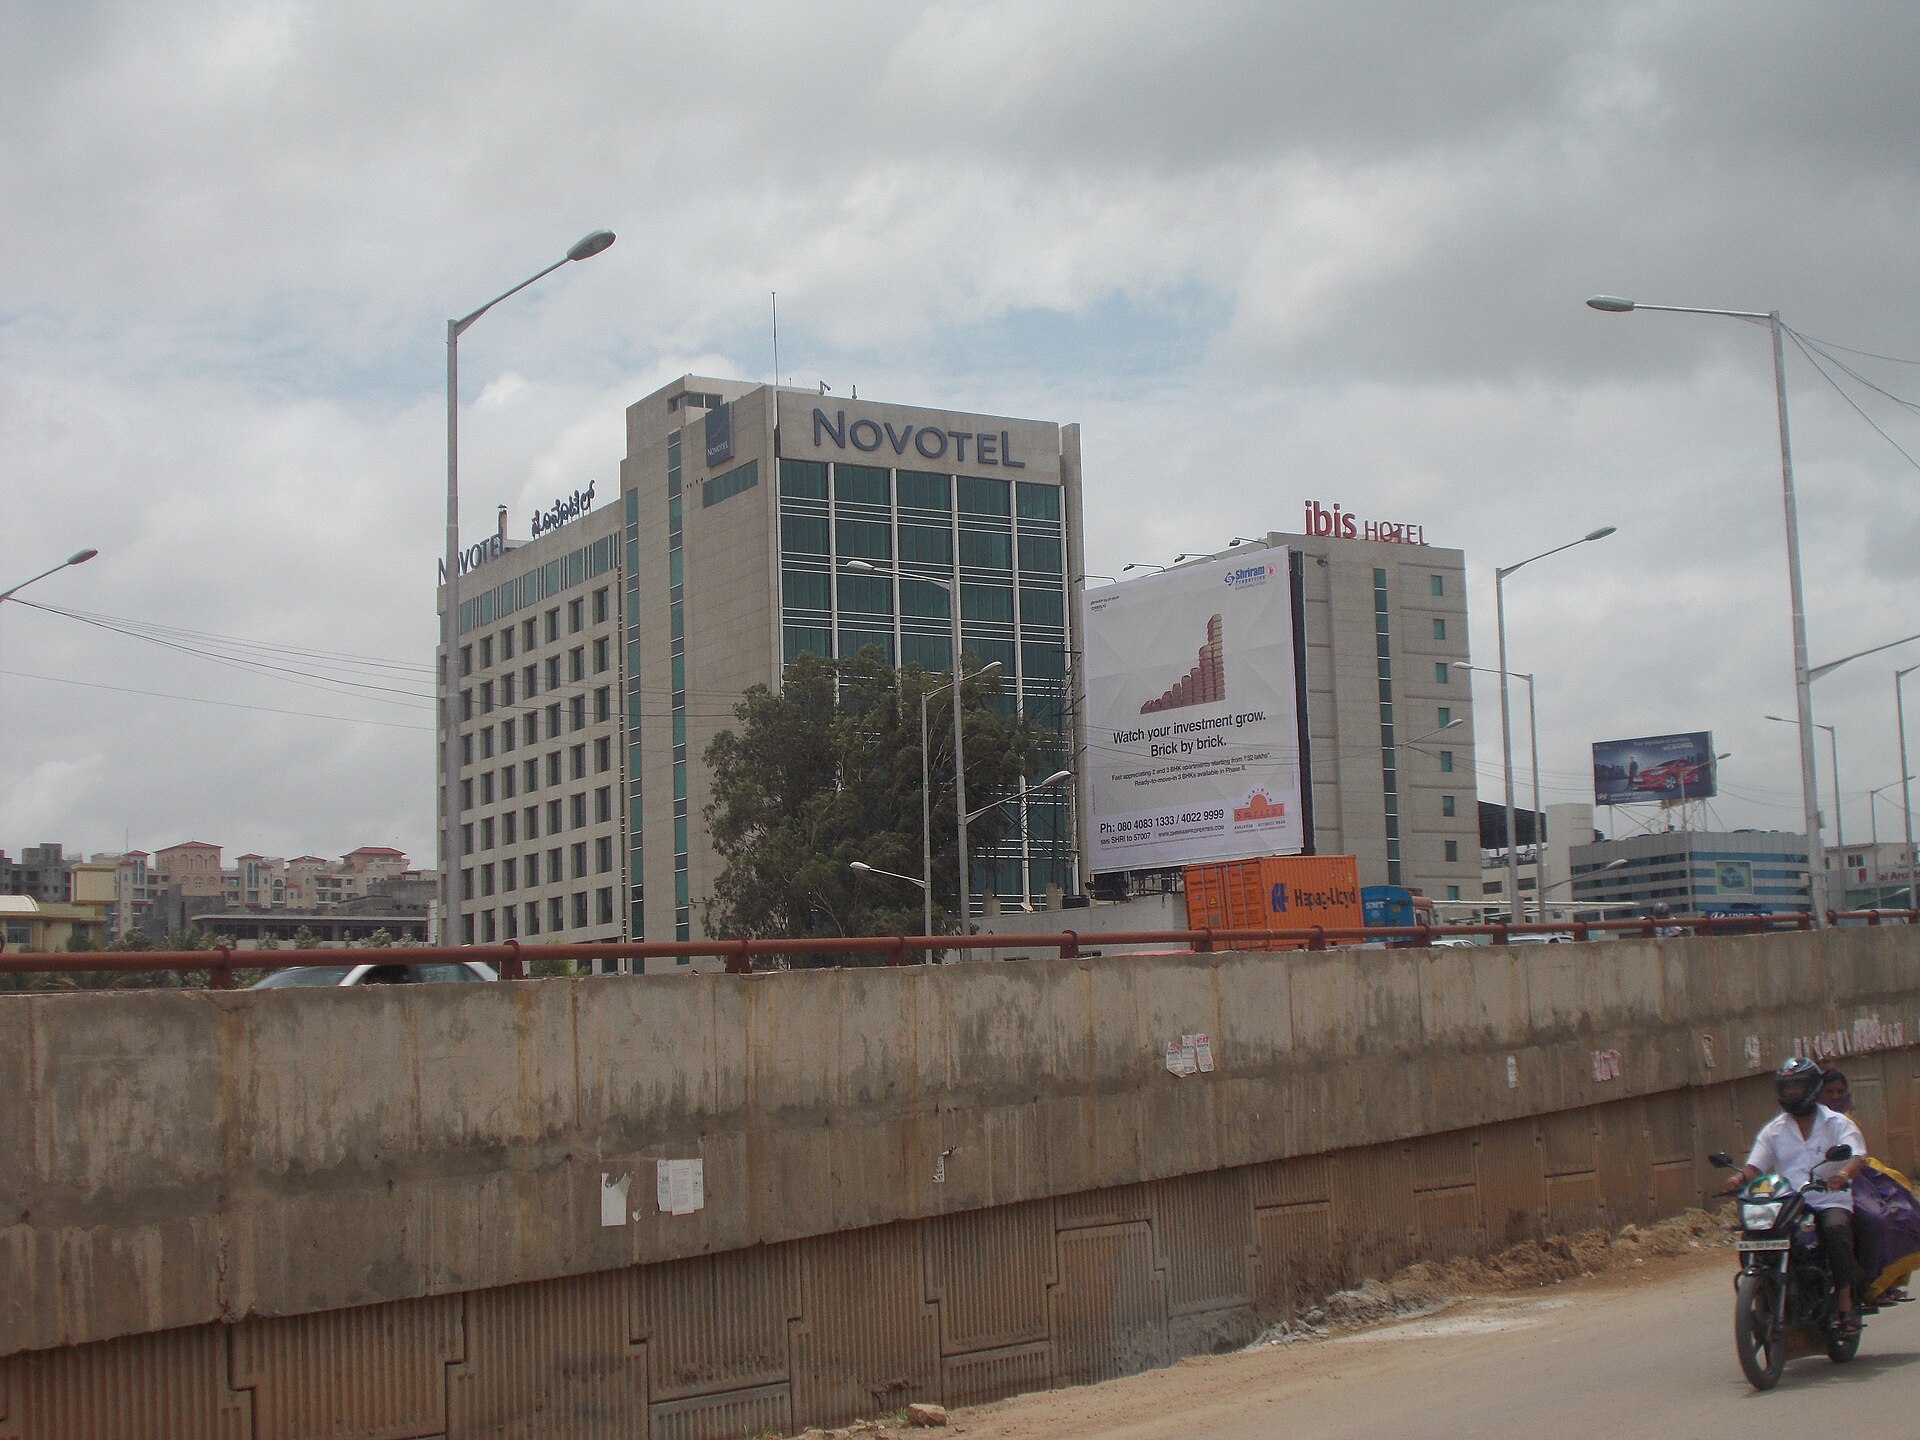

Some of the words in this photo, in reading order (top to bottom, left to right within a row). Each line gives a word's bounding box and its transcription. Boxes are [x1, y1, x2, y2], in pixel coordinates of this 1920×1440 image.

[813, 408, 1025, 468] NOVOTEL
[1304, 500, 1357, 539] ibis
[1364, 520, 1430, 546] HOTEL
[1235, 565, 1265, 580] Shriram
[1113, 728, 1145, 744] Watch
[1147, 726, 1171, 742] your
[1173, 714, 1233, 735] investment
[1235, 711, 1266, 728] grow.
[1151, 741, 1178, 757] Brick
[1180, 740, 1194, 755] by
[1196, 734, 1227, 750] brick.
[1100, 823, 1115, 834] Ph:
[1117, 821, 1132, 832] 080
[1133, 818, 1153, 830] 4083
[1155, 815, 1175, 827] 1333
[1181, 812, 1202, 823] 4022
[1203, 809, 1224, 821] 9999
[1111, 835, 1126, 844] SHRI
